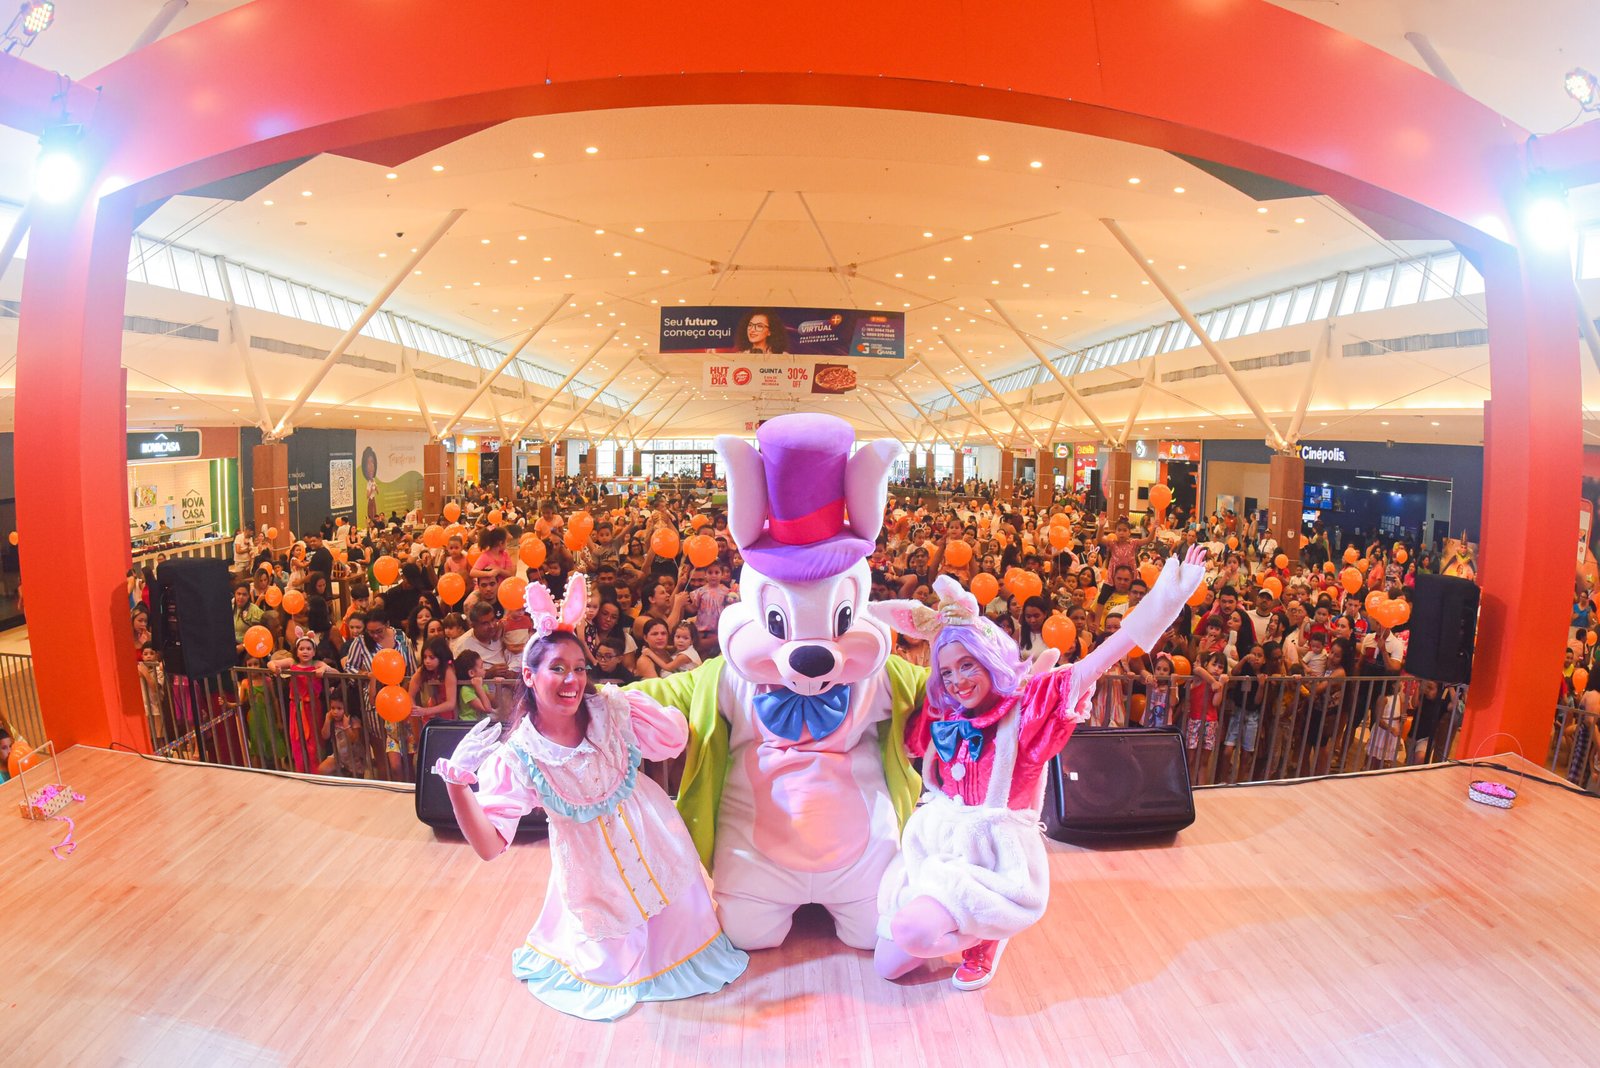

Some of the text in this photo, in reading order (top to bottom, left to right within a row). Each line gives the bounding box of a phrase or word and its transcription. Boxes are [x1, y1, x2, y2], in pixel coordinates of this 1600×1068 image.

[664, 317, 718, 327] Seu futuro
[663, 328, 731, 339] começa aqui
[801, 324, 832, 333] VIRTUAL
[710, 366, 729, 374] HUT
[787, 367, 808, 380] 30%
[711, 377, 727, 385] DIA
[182, 497, 205, 509] NOVA
[182, 508, 205, 519] CASA
